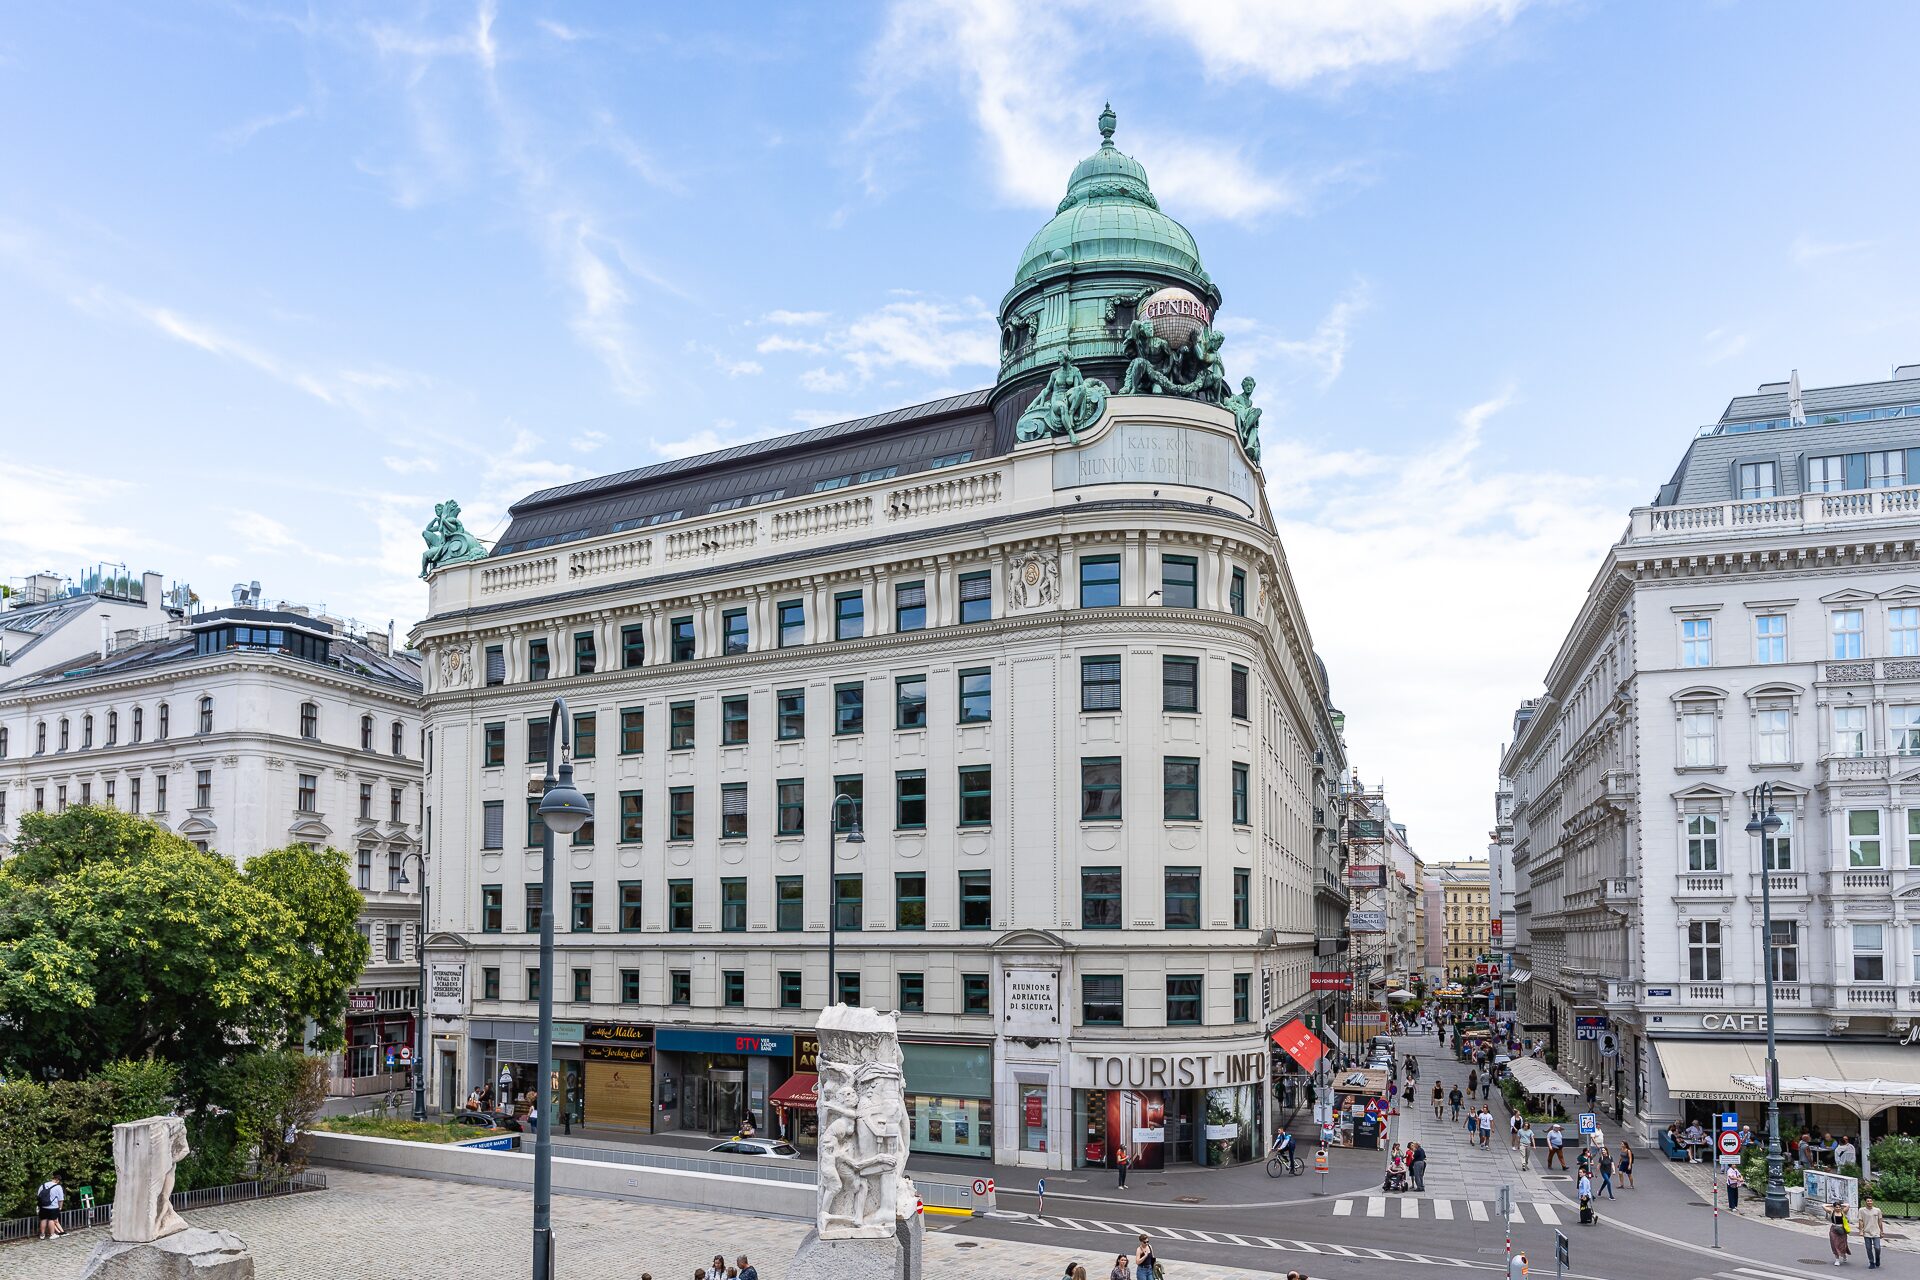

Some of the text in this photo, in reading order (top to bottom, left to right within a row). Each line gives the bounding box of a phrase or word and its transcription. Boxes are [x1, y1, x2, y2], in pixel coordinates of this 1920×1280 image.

[1080, 457, 1145, 476] RIUNIONE
[1012, 983, 1051, 991] RIUNIONE
[1011, 993, 1051, 1001] ADRIATICA
[604, 1026, 643, 1039] Müller
[736, 1037, 760, 1051] BTV
[1086, 1051, 1265, 1087] TOURIST-INFO
[1702, 1092, 1756, 1101] RESTAURANT
[1760, 1094, 1794, 1102] MART
